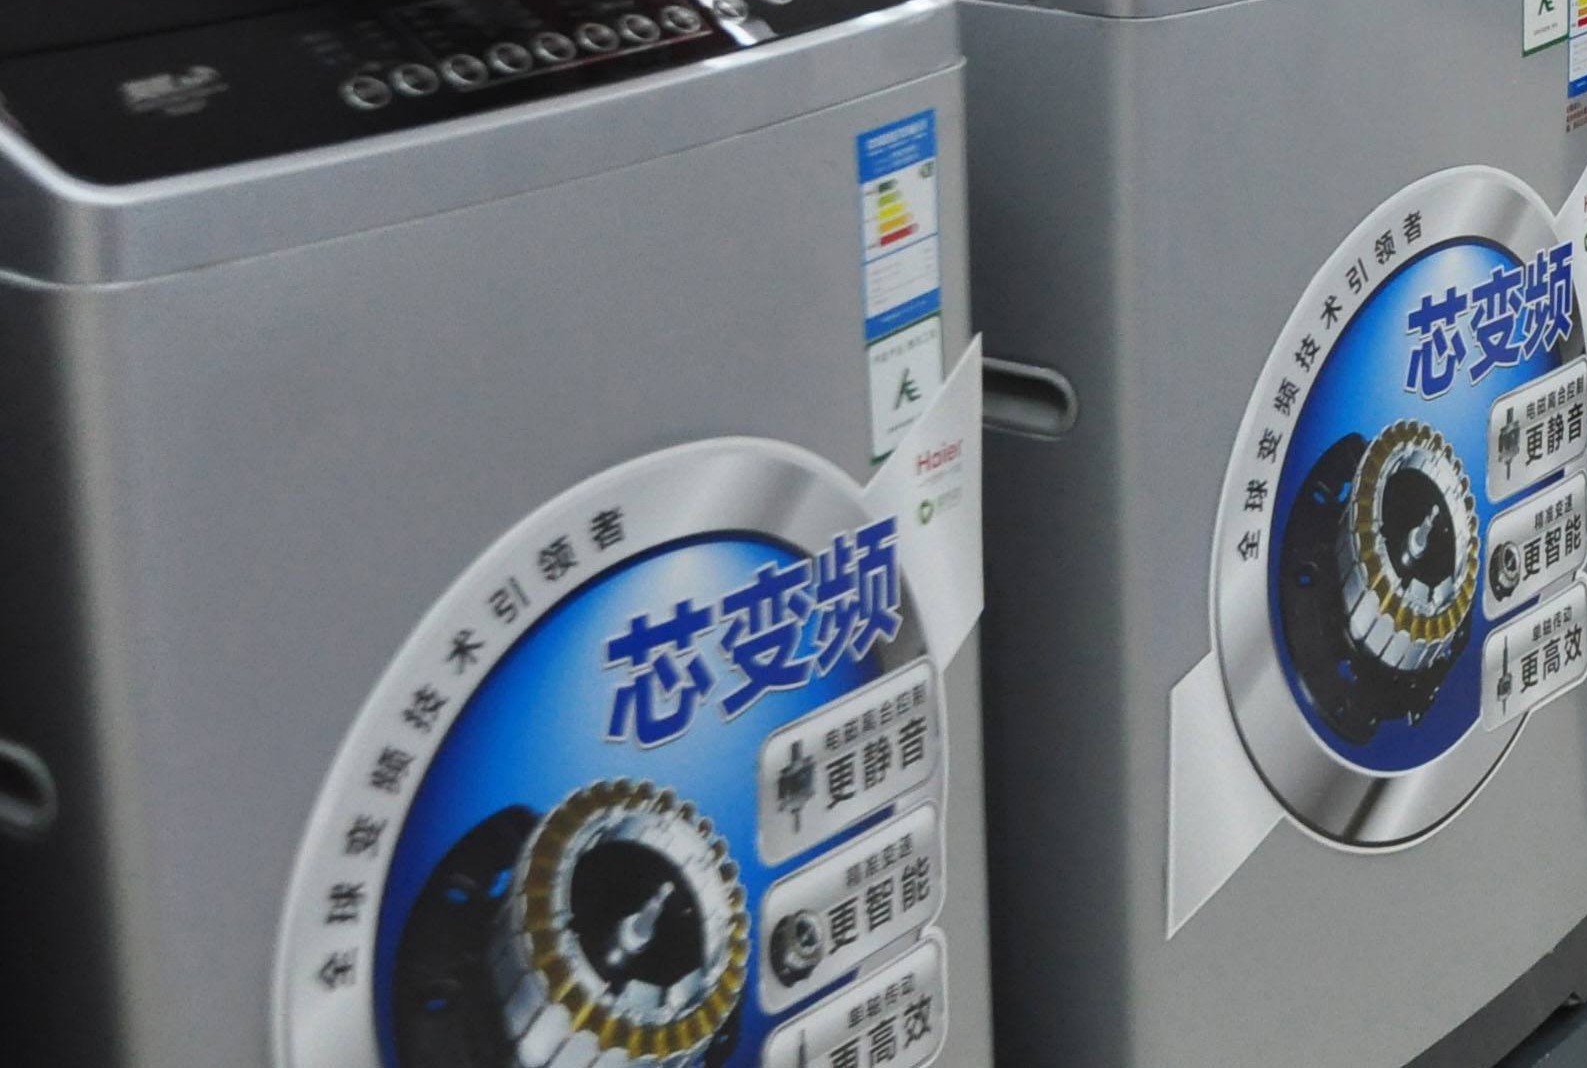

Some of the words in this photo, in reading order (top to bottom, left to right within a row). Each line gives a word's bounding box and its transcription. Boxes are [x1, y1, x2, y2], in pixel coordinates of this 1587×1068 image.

[1404, 240, 1573, 400] 芯变频
[1236, 210, 1424, 562] 全球变频技术引领者
[1524, 402, 1585, 467] 更静音
[915, 435, 963, 478] Haier
[1521, 512, 1583, 584] 更智能
[603, 514, 903, 749] 芯变频
[1520, 622, 1584, 696] 更高效
[317, 505, 628, 991] 全球变频技术引领者
[825, 715, 929, 812] 更静音
[827, 855, 931, 957] 更智能
